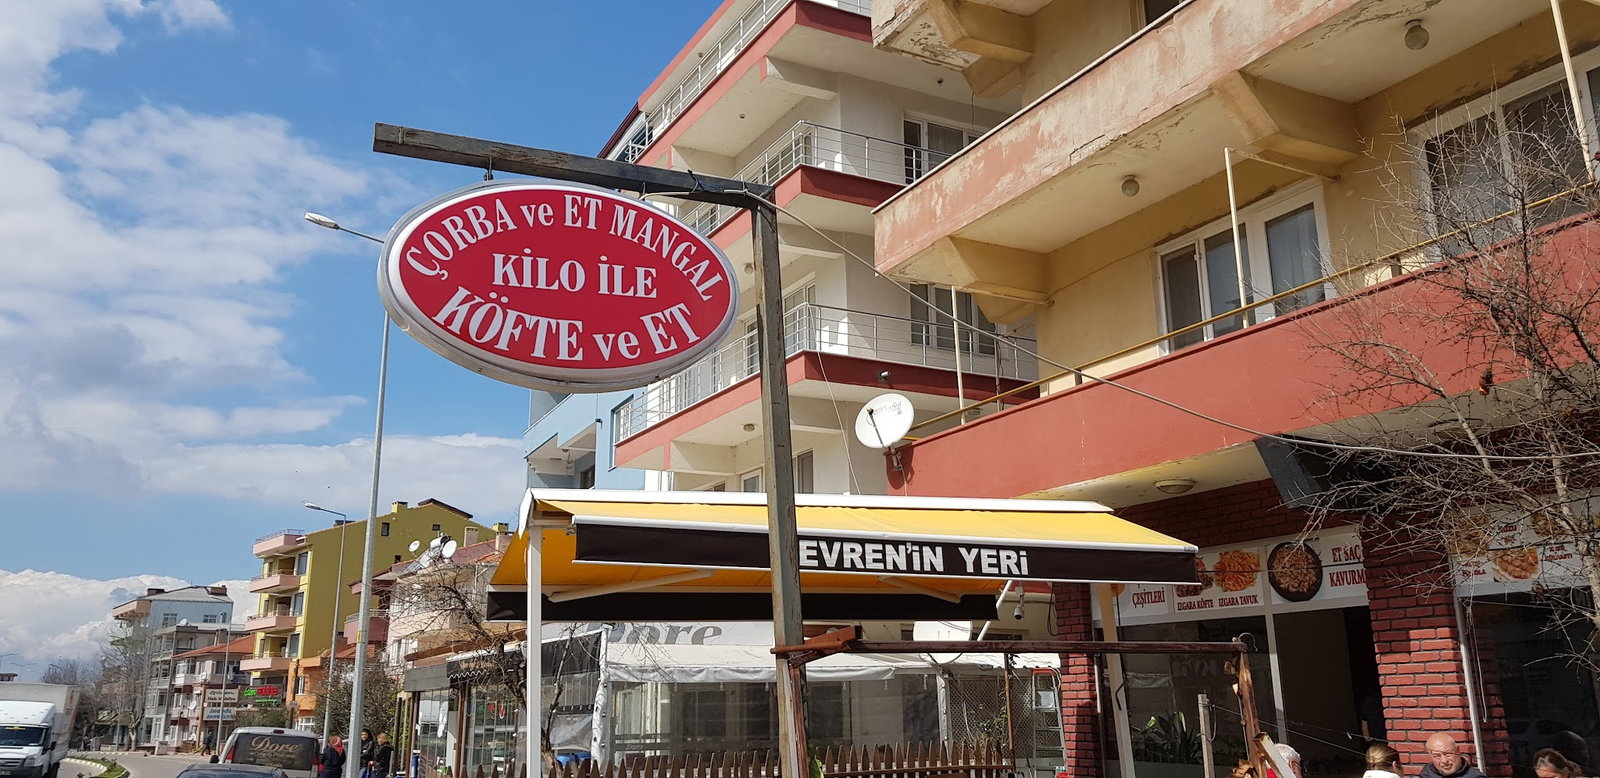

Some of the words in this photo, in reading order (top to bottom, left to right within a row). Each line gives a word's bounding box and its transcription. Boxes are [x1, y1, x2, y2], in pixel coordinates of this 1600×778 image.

[406, 198, 518, 281] ÇORBA
[520, 202, 554, 228] ve
[563, 194, 602, 230] ET
[609, 203, 725, 302] MANGAL
[492, 248, 586, 293] KİLO
[597, 255, 658, 299] İLE
[431, 285, 584, 361] KÖFTE
[592, 331, 641, 362] ve
[640, 302, 701, 355] ET
[1329, 569, 1367, 587] KAVURM
[1331, 547, 1342, 562] ET
